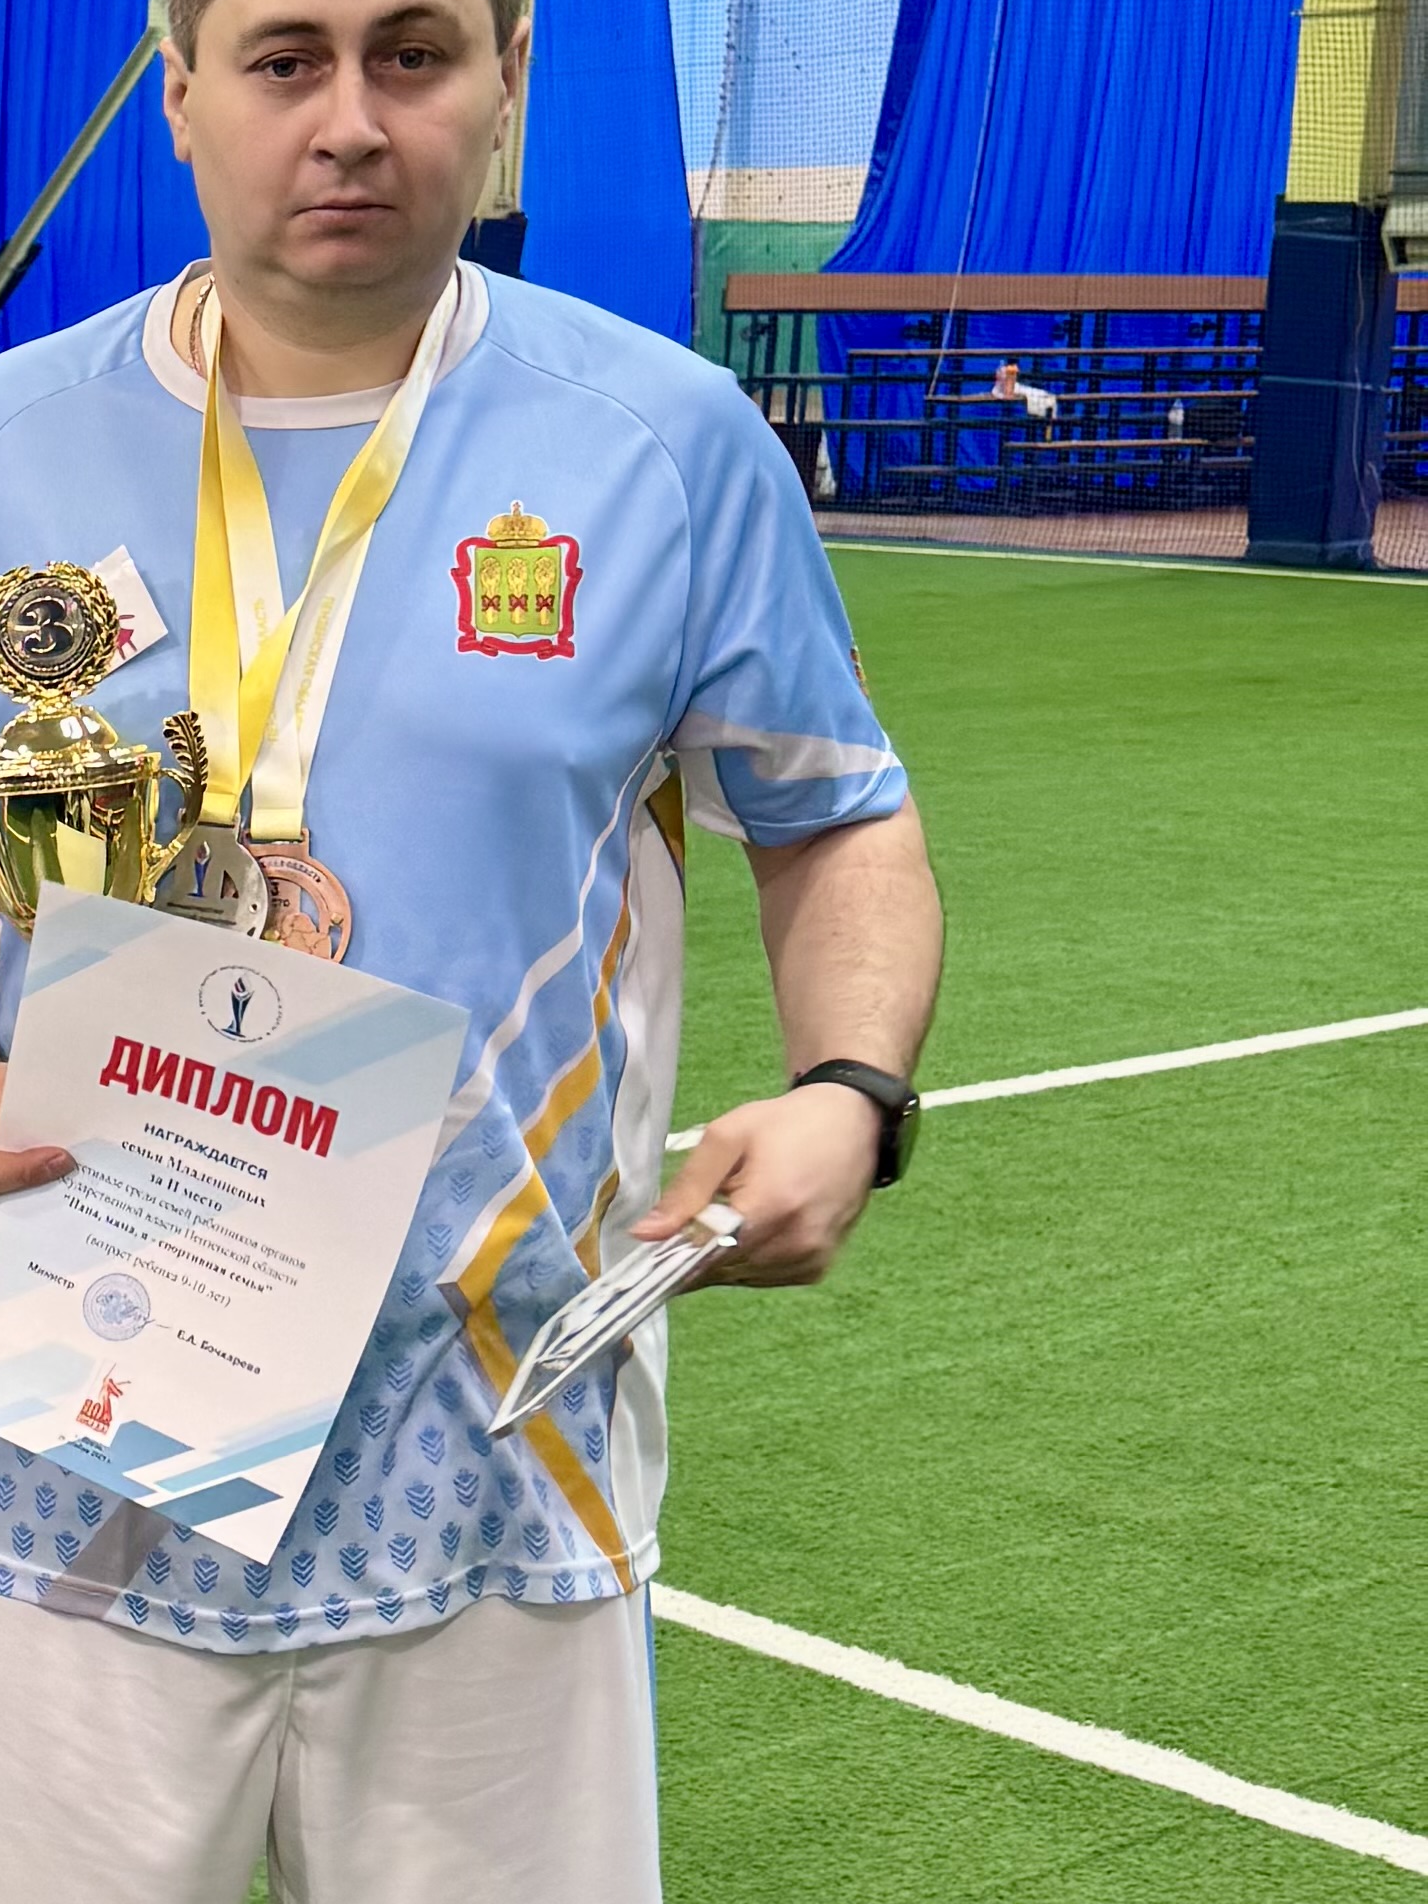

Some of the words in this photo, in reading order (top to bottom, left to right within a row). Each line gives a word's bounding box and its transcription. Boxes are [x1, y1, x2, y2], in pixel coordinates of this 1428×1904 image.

[18, 597, 74, 656] 3
[99, 1035, 340, 1158] ДИПЛОМ
[120, 1139, 163, 1164] семья
[143, 1122, 269, 1182] НАГРАЖДАЕТСЯ
[166, 1178, 179, 1192] II
[180, 1187, 223, 1213] место
[26, 1260, 76, 1291] Министр
